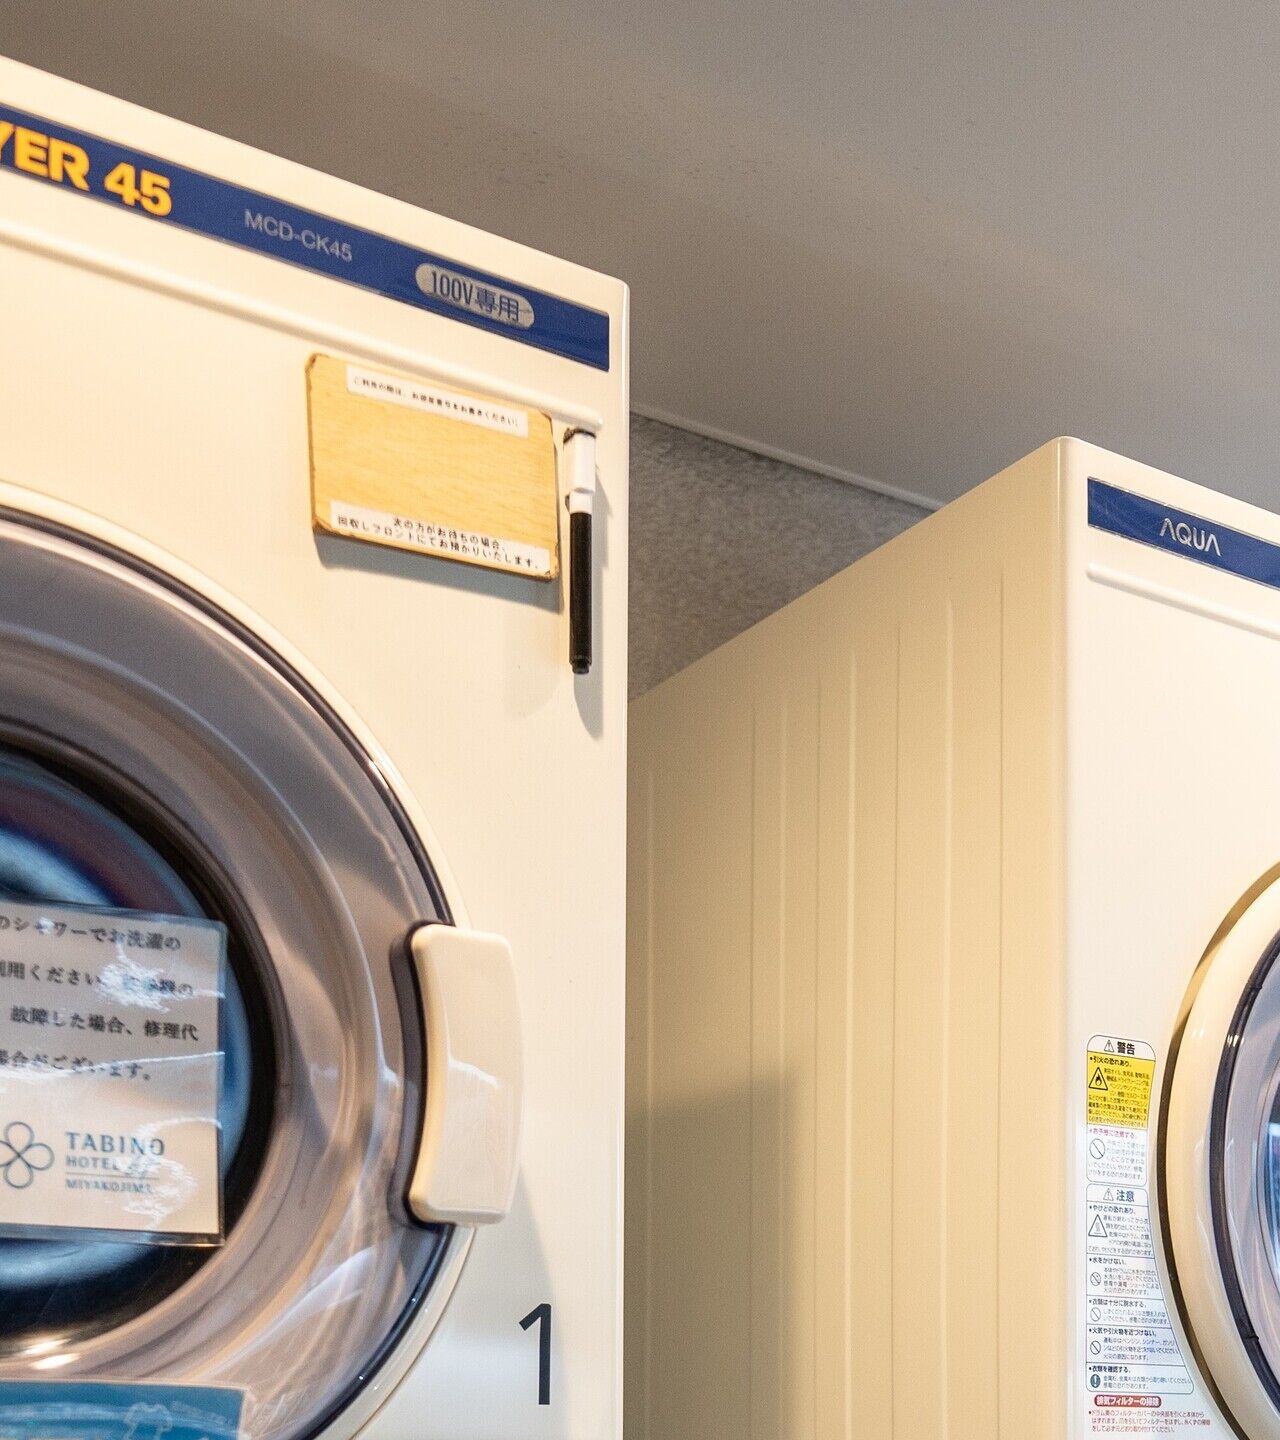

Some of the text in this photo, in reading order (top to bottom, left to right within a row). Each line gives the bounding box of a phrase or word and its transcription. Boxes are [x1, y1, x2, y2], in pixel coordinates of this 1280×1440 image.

[104, 163, 172, 217] 45
[244, 208, 353, 263] MCD-CK45
[431, 269, 520, 323] 100V専用
[1159, 517, 1222, 556] AQUA
[1117, 1041, 1135, 1055] 警告
[65, 1131, 165, 1156] TABINO
[1117, 1189, 1134, 1202] 注意
[518, 1303, 552, 1406] 1
